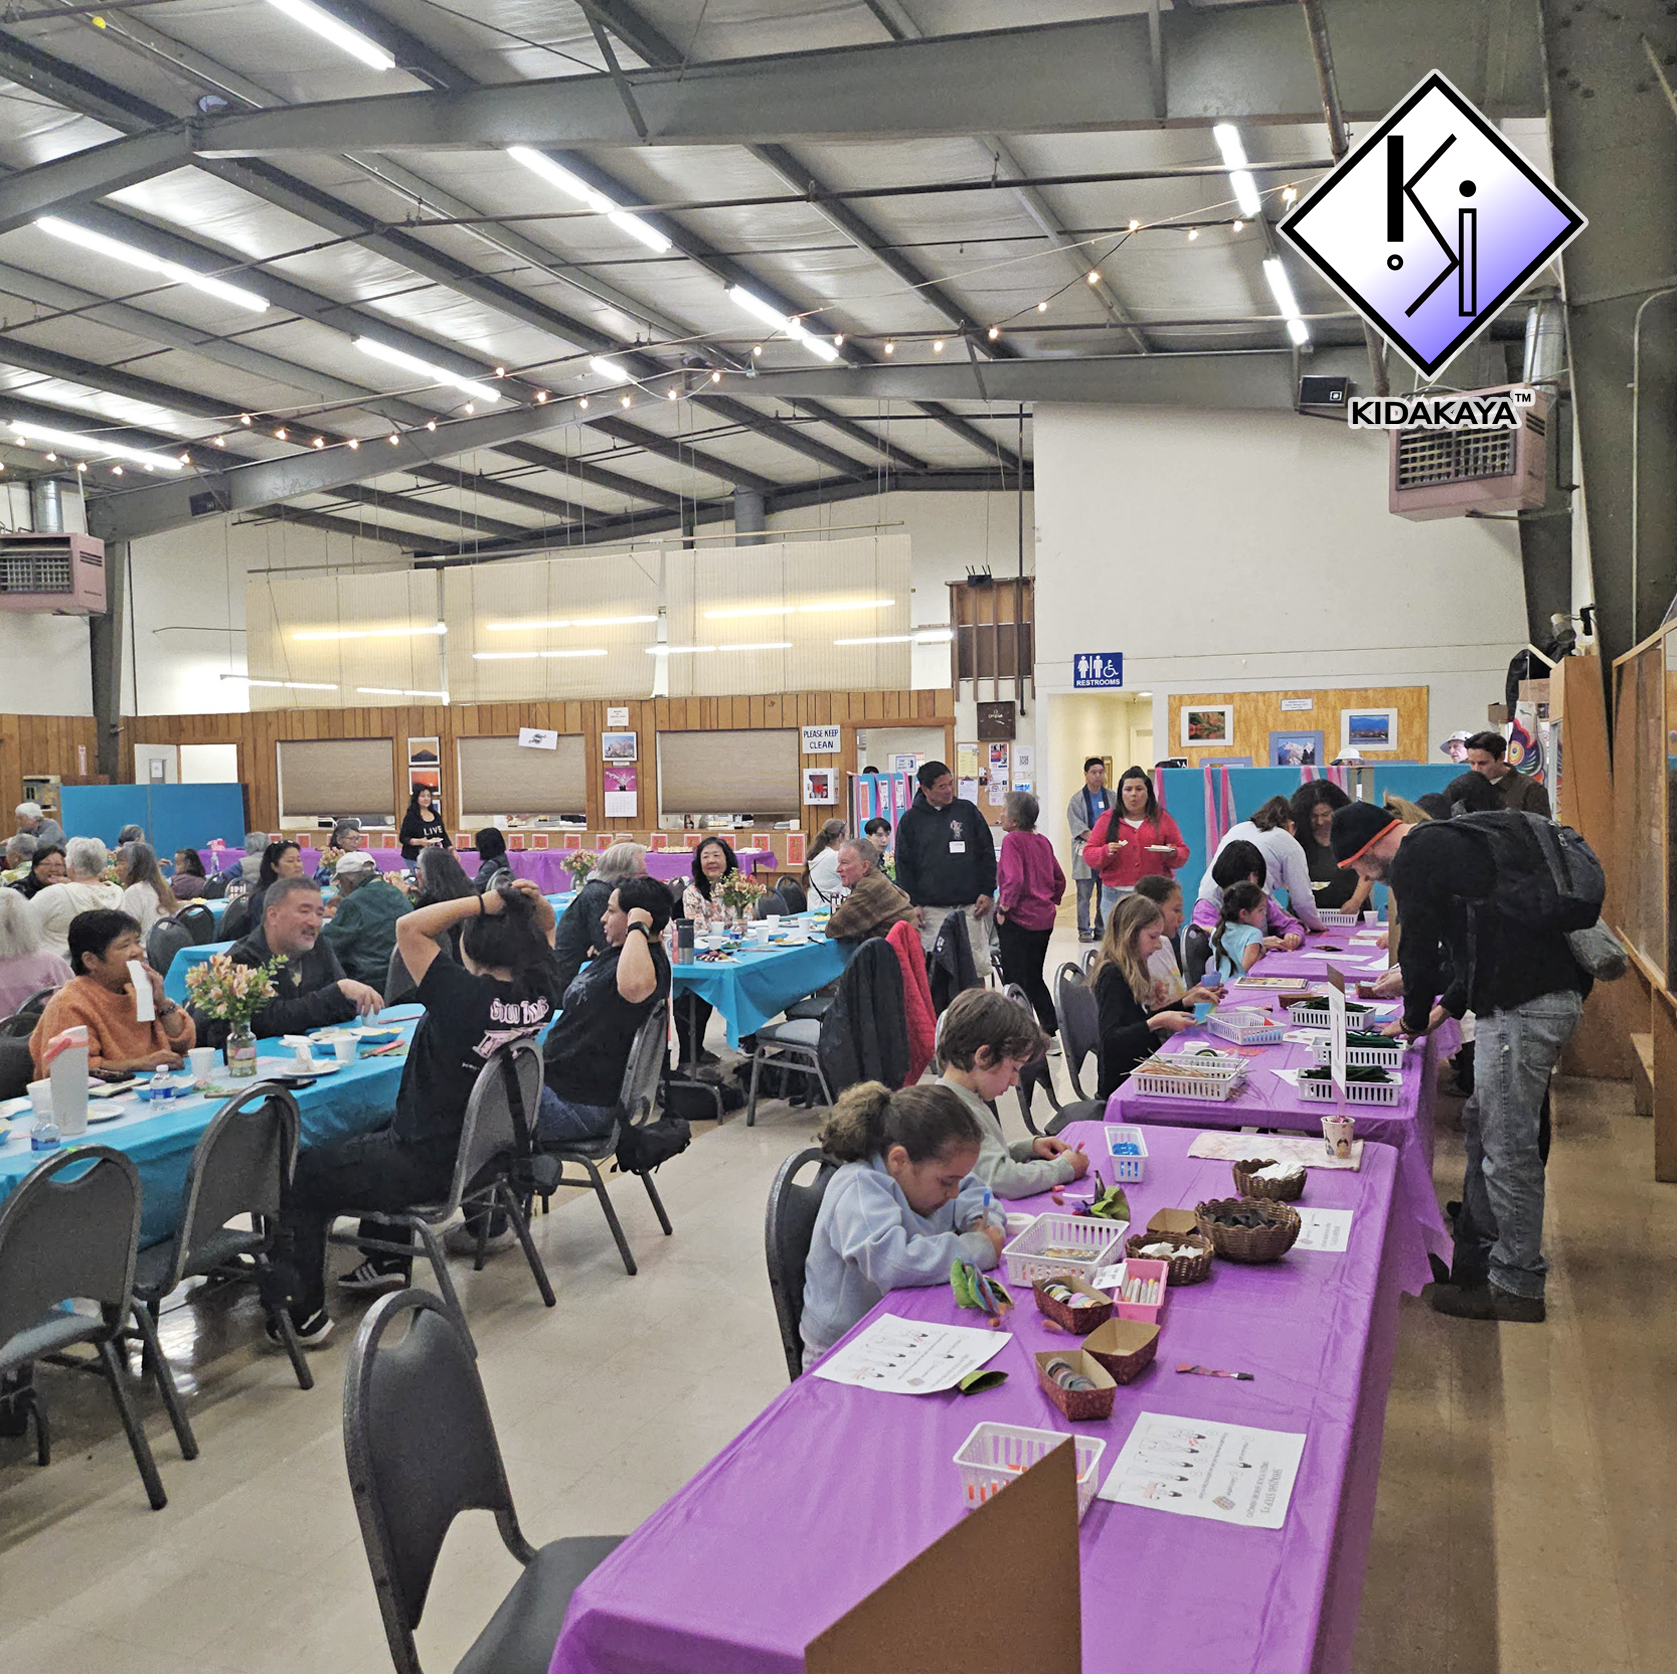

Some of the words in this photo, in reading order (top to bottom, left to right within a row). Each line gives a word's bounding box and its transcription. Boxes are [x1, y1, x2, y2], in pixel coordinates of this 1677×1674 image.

[1076, 678, 1120, 686] RESTROOMS
[804, 730, 823, 738] PLEASE
[824, 729, 838, 737] KEEP
[809, 741, 834, 749] CLEAN
[423, 825, 443, 836] LIVE
[1263, 1492, 1276, 1507] STEP
